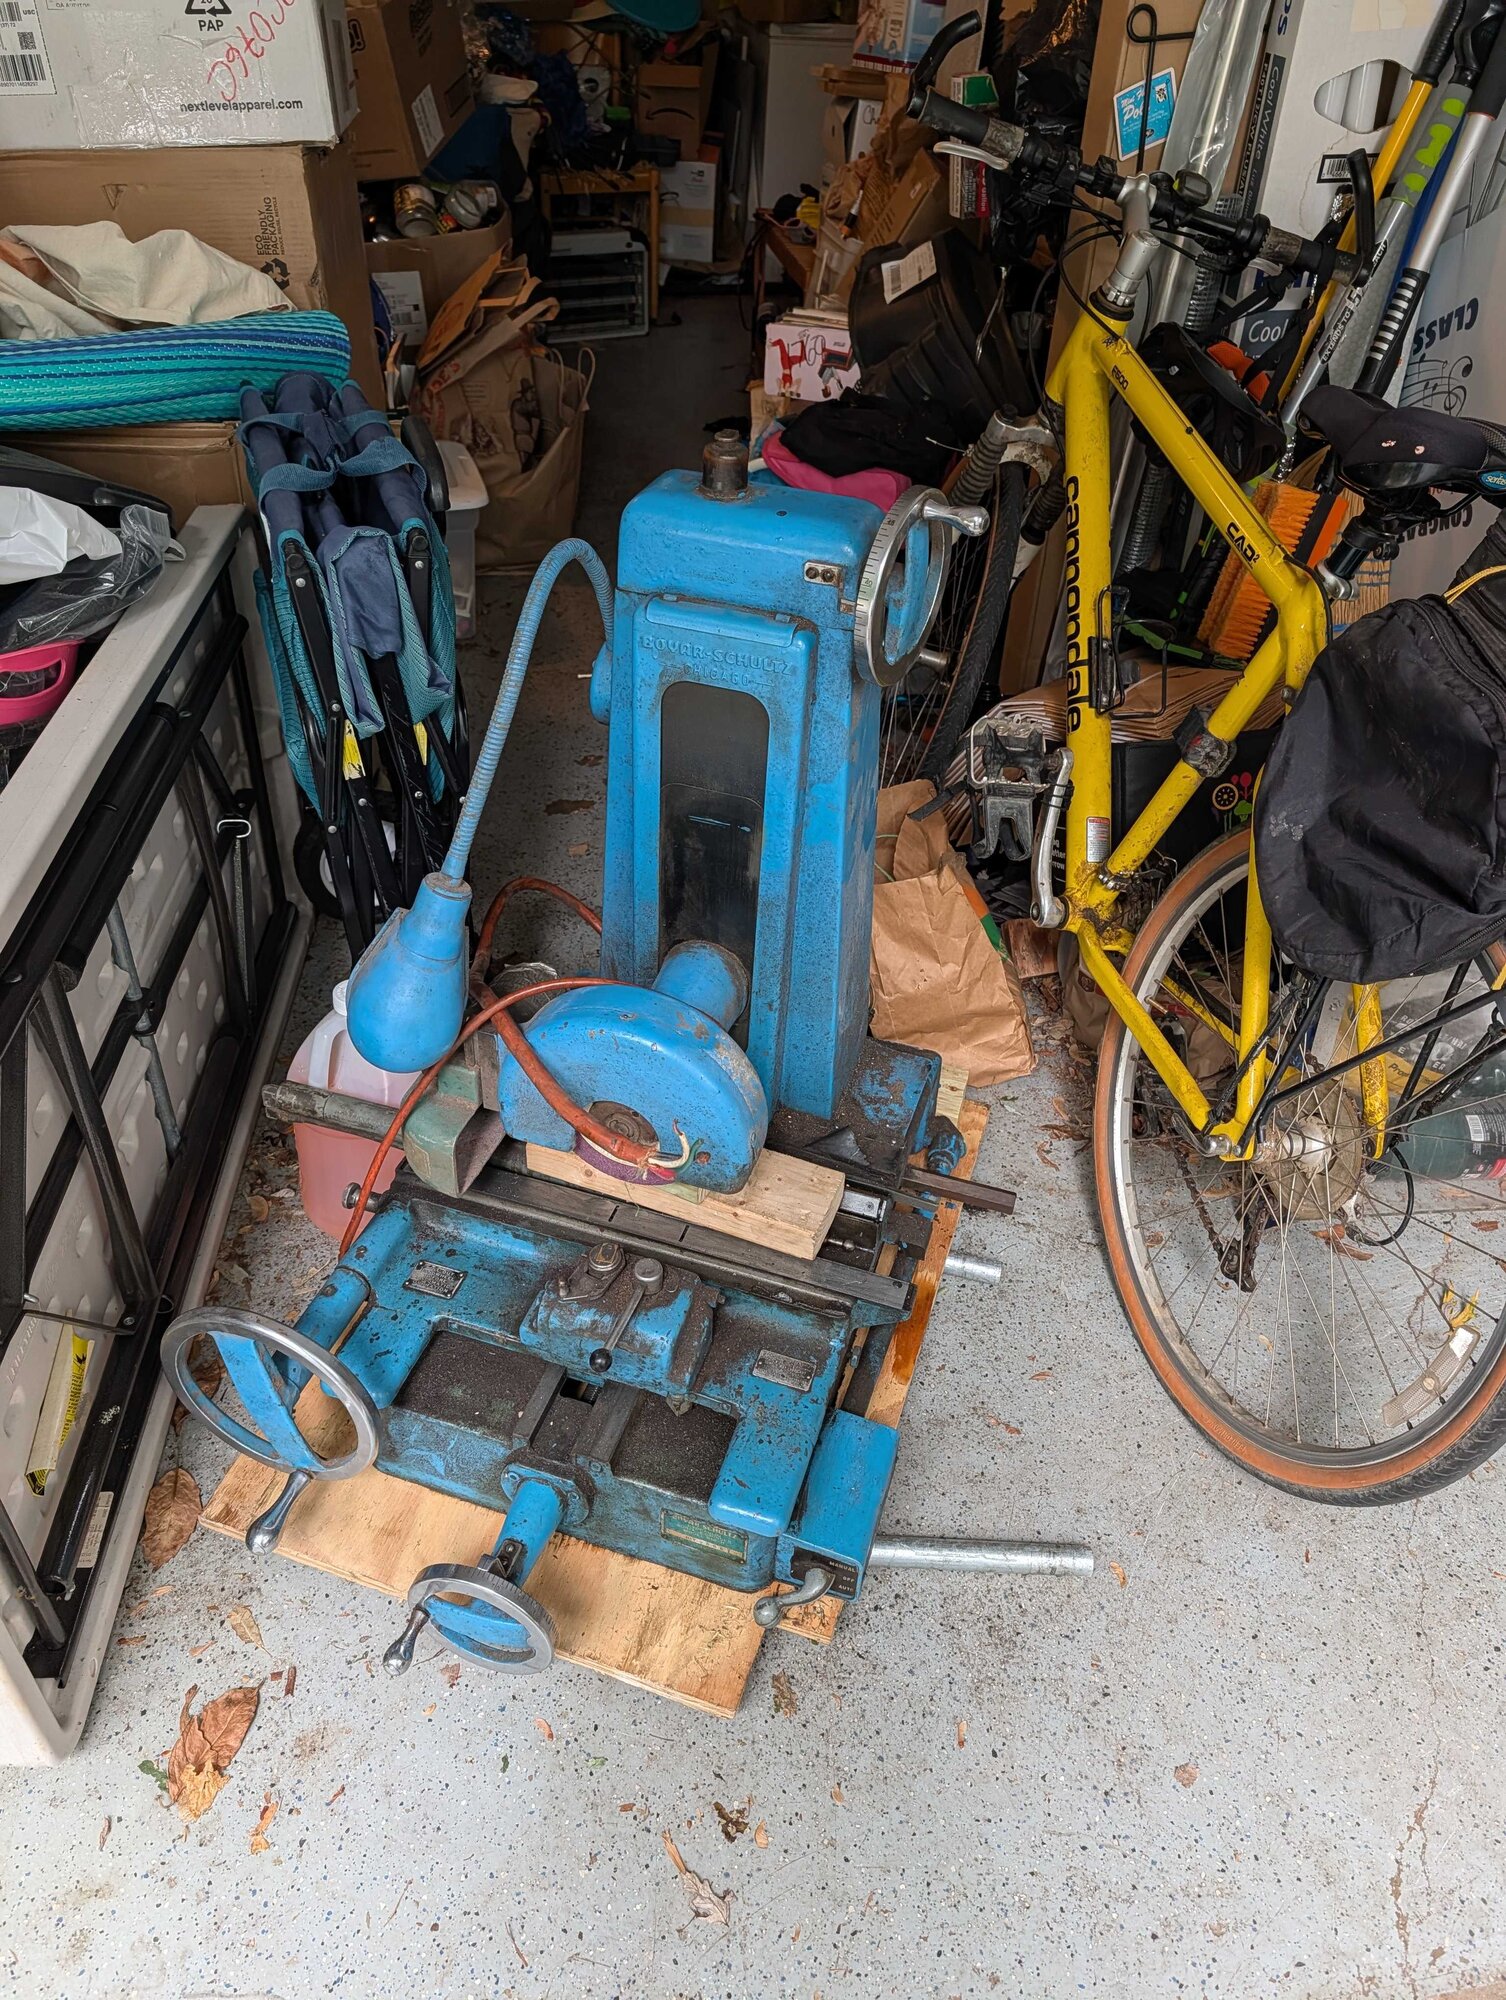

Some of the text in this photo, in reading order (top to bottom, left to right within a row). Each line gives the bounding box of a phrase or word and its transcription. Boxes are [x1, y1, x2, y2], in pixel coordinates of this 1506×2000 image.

[198, 20, 224, 31] PAP
[1266, 66, 1279, 107] Cool
[180, 99, 303, 113] nextlevelapparel.com
[1256, 109, 1272, 159] White
[257, 209, 272, 256] FRIENDLY
[263, 196, 280, 256] PACKAGING
[254, 234, 265, 256] ECO
[1248, 318, 1289, 343] Cool
[1412, 297, 1479, 355] CLASS
[1064, 475, 1089, 734] cannondale
[683, 663, 750, 688] CHICAGO
[829, 1560, 856, 1574] MANUAL
